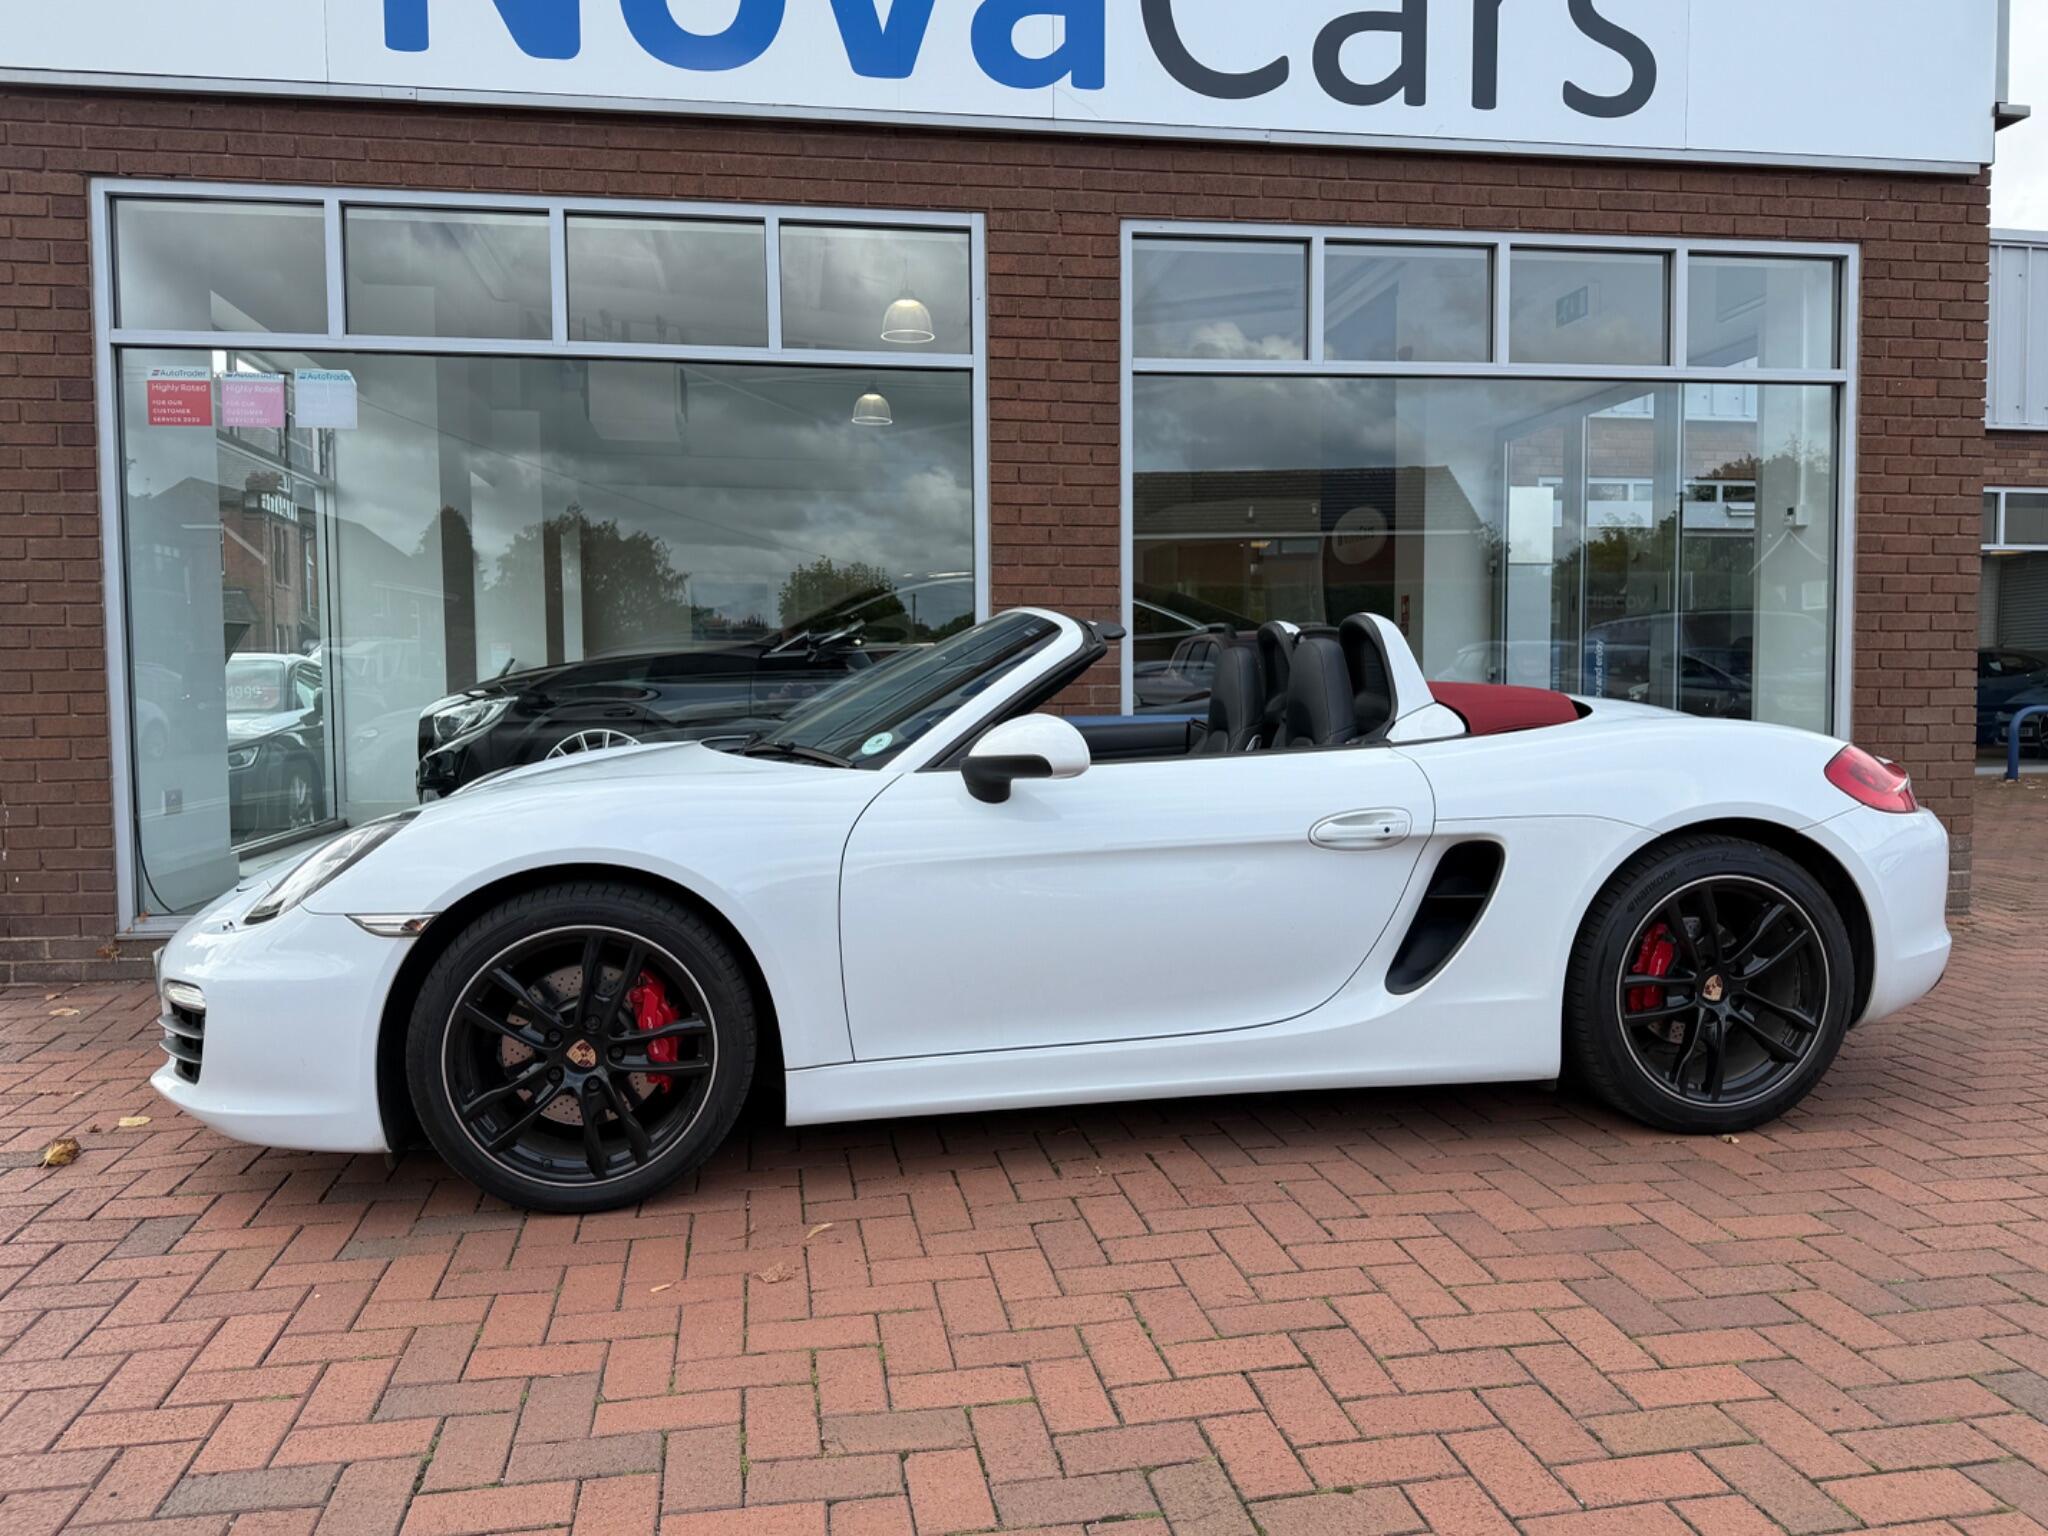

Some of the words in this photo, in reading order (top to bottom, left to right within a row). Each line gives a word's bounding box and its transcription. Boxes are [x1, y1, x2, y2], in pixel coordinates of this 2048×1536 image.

[383, 0, 1657, 118] vaCars
[160, 369, 207, 377] AutoTrader
[152, 383, 179, 392] Highly
[180, 384, 207, 392] Rated
